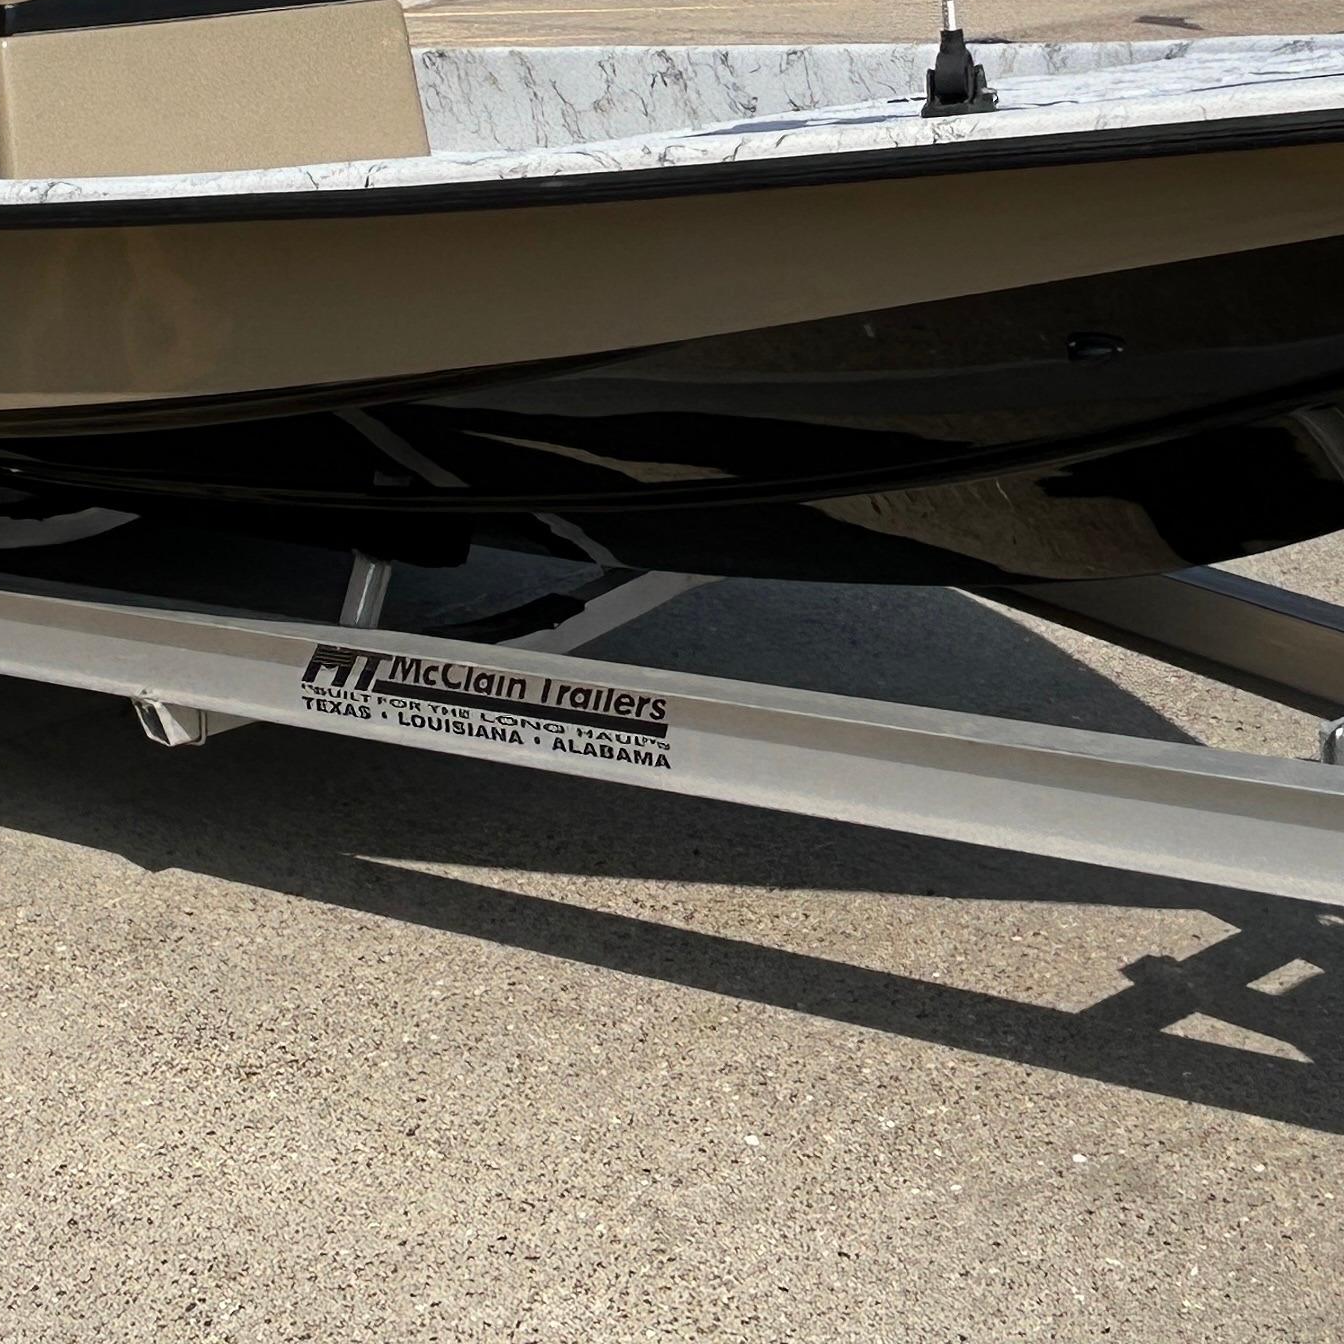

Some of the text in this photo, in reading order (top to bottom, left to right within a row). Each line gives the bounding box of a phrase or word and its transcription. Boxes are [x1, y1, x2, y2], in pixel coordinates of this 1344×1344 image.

[388, 656, 526, 700] McClain
[541, 678, 667, 720] Trailers
[301, 696, 671, 769] TEXAS LOUISIANA ALABAMA
